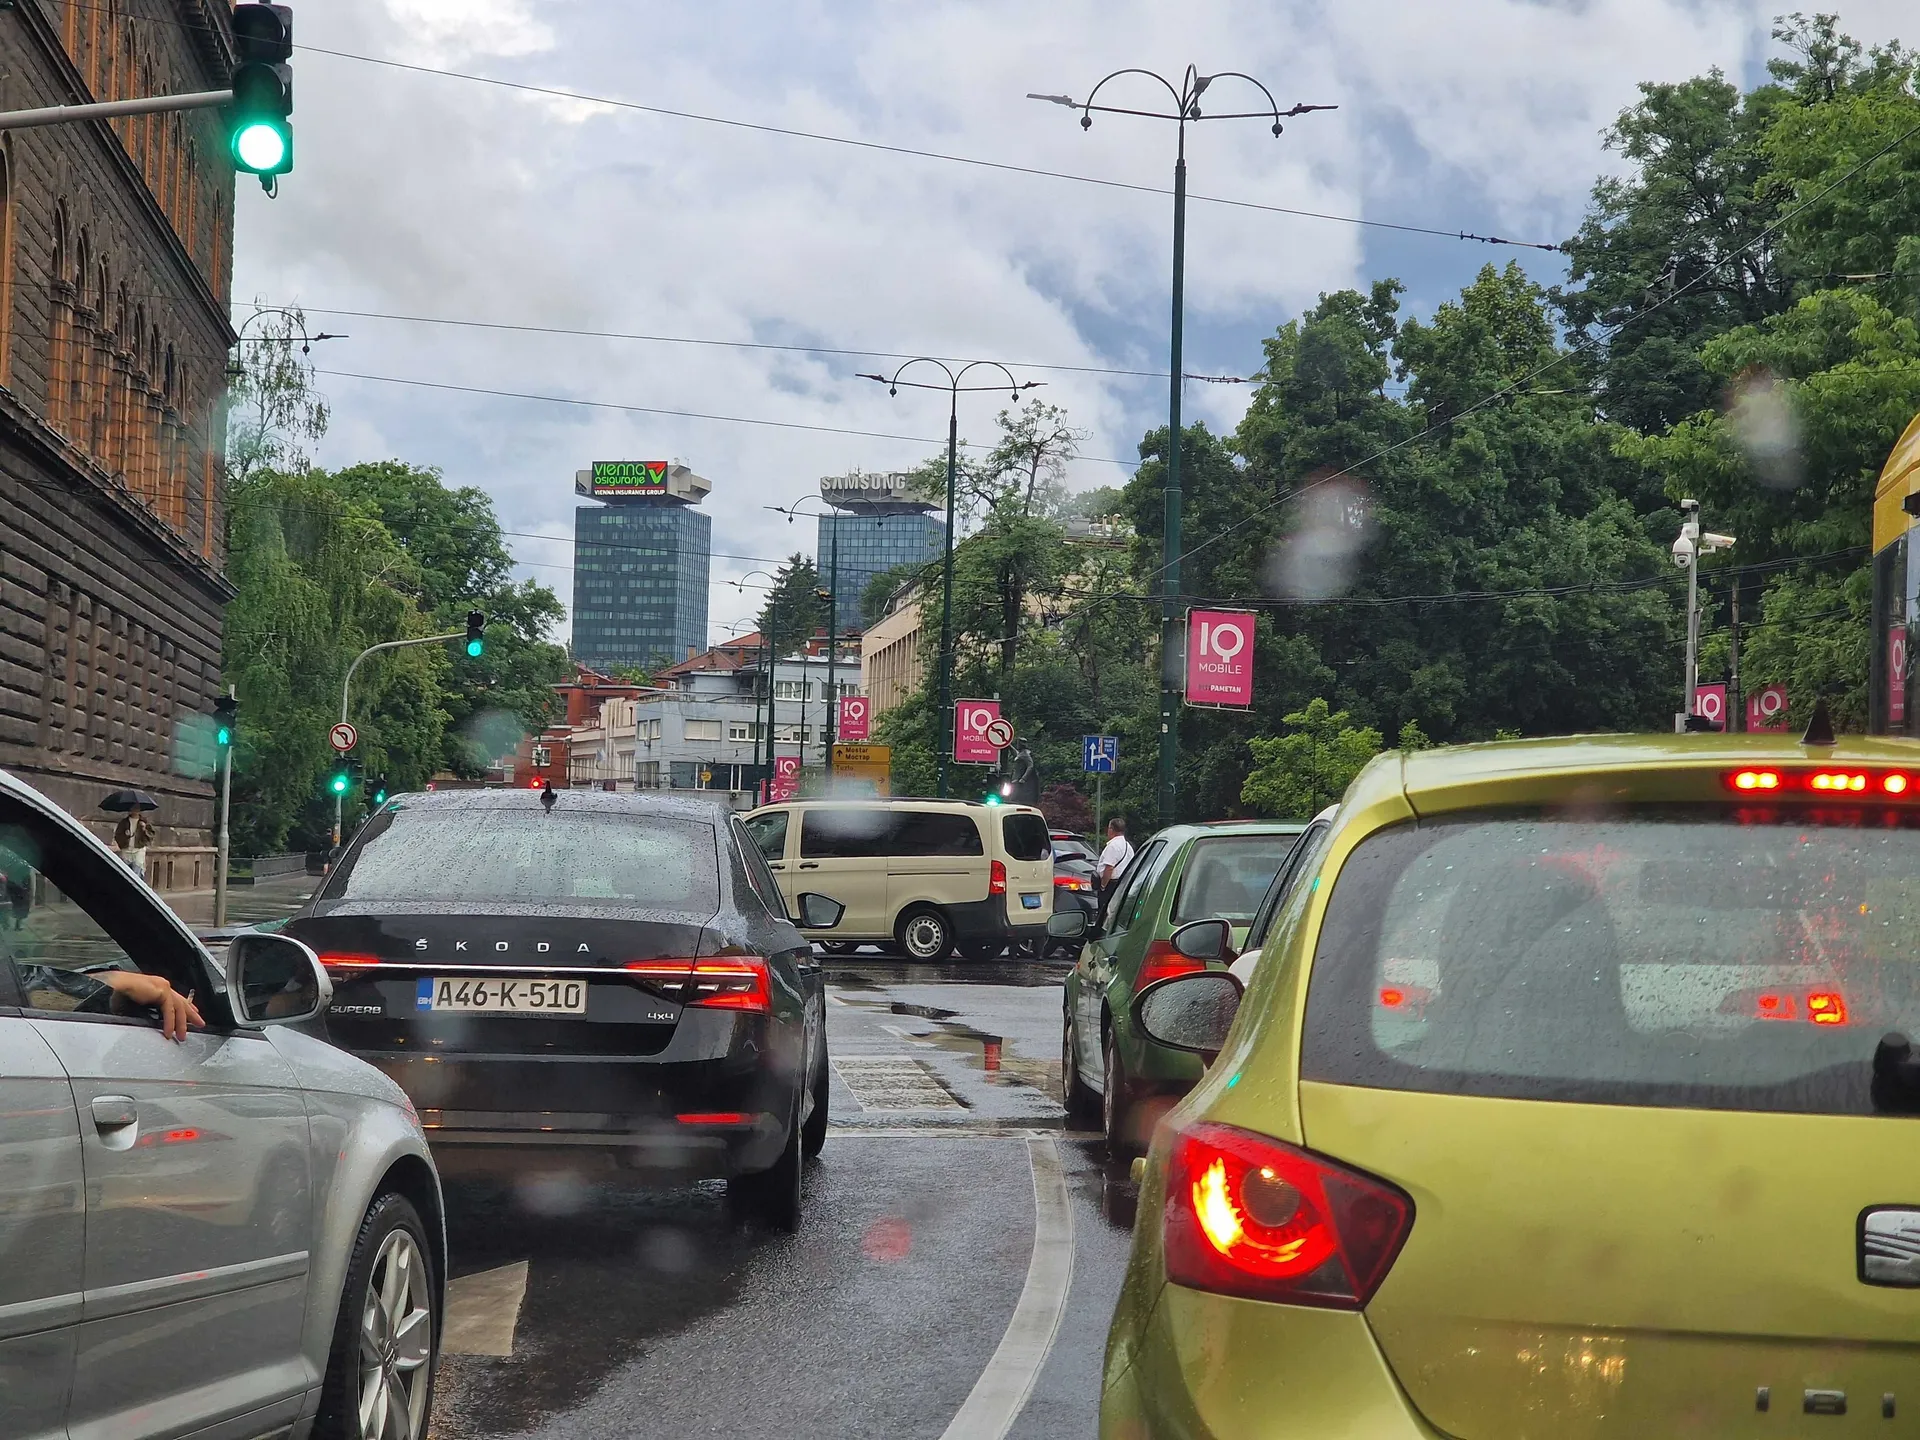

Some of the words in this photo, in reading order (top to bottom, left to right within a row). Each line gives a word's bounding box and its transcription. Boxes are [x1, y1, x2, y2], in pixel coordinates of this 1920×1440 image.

[594, 463, 646, 475] vienna
[594, 476, 646, 487] osiguranje
[821, 475, 906, 490] SAMSUNG
[1200, 622, 1244, 663] IQ
[1199, 663, 1242, 674] MOBILE
[844, 701, 864, 720] IQ
[1696, 693, 1720, 720] IQ
[964, 708, 992, 735] IQ
[416, 938, 590, 953] ŠKODA
[436, 981, 581, 1008] A46-K-510
[330, 1006, 382, 1014] SUPERB
